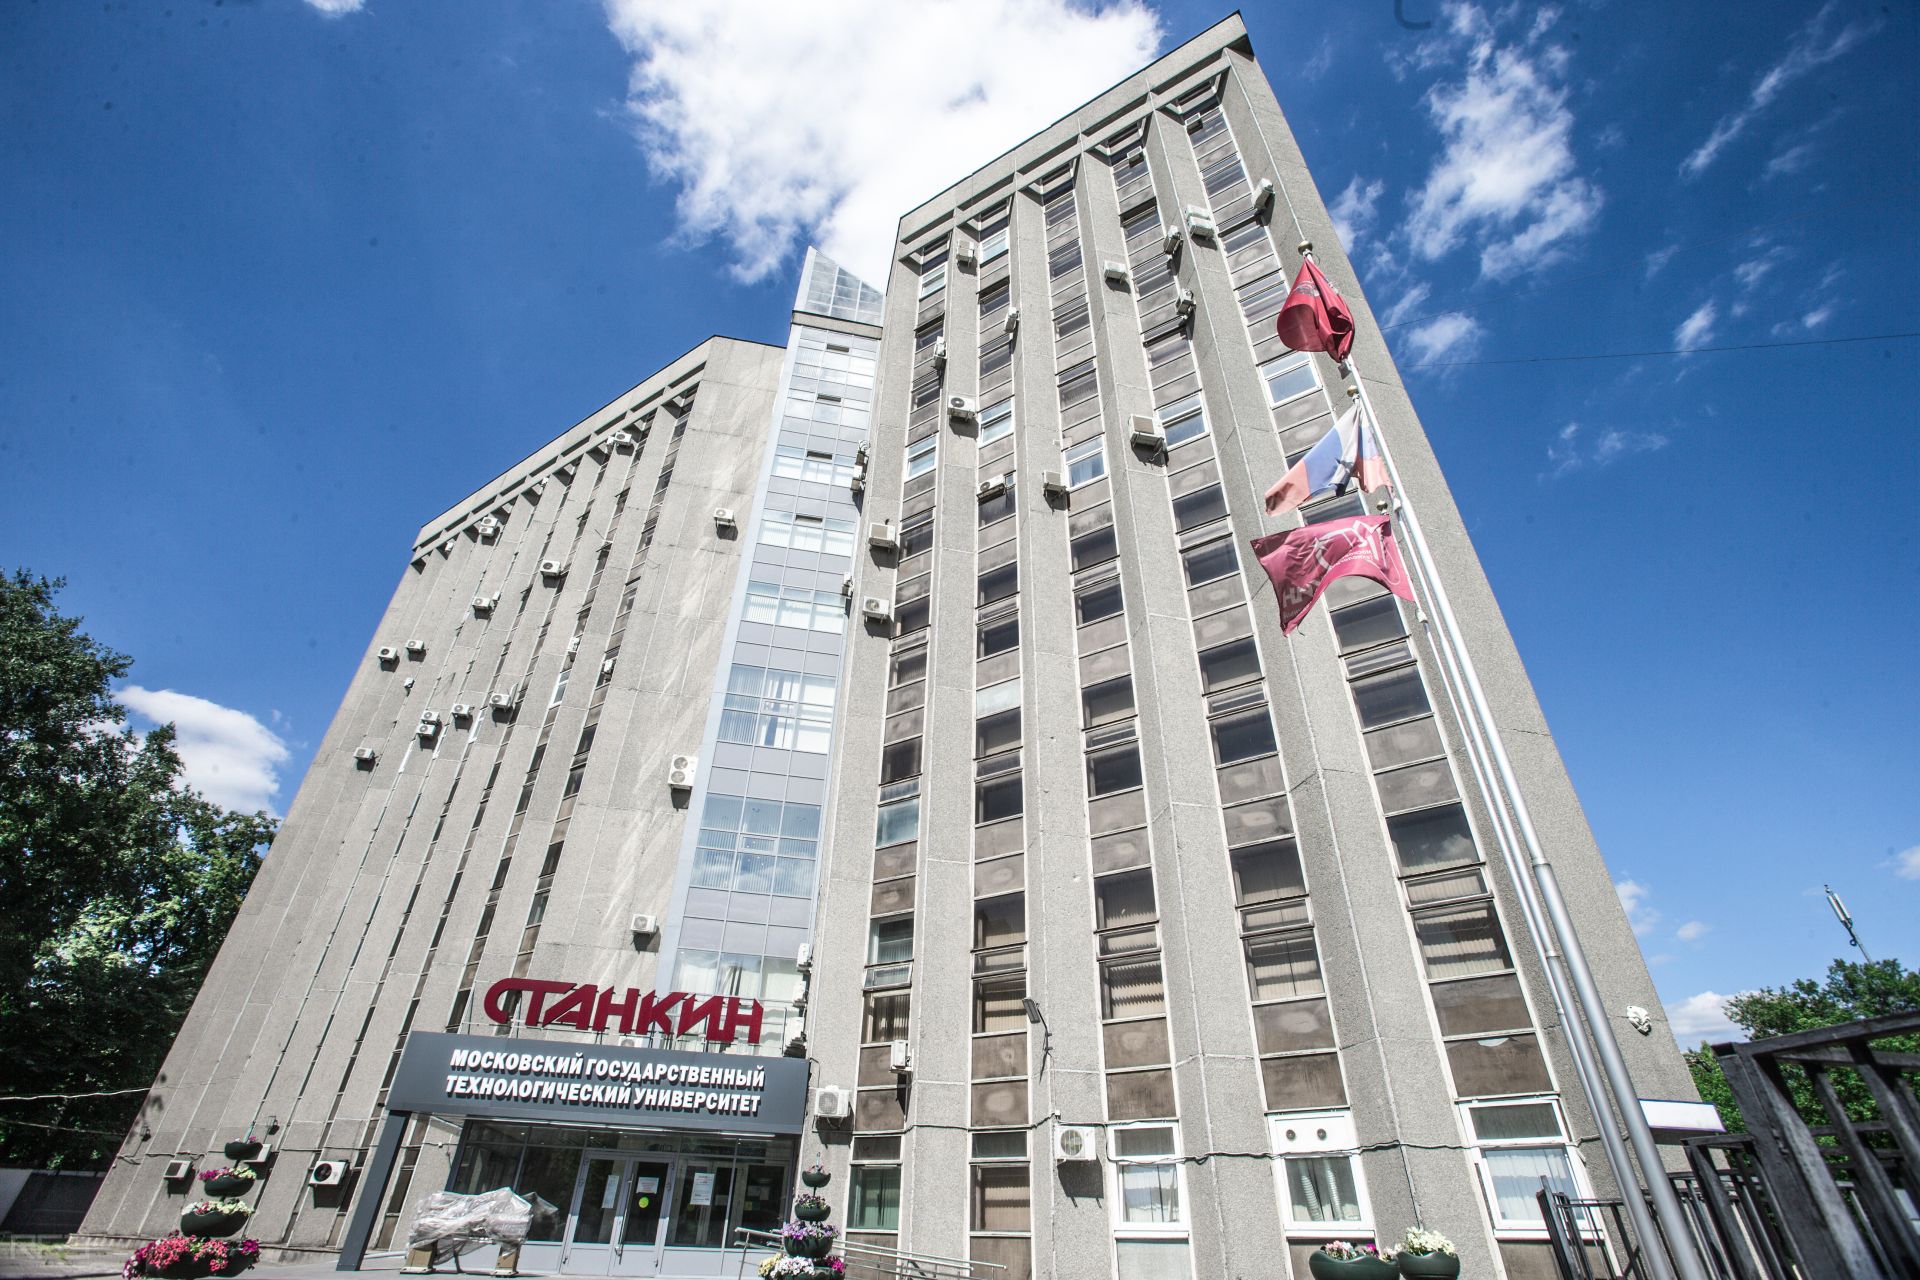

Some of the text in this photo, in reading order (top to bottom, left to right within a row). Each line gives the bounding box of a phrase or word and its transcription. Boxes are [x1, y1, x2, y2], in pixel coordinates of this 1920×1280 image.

[484, 978, 764, 1044] СТАНКИН
[450, 1049, 765, 1088] МОСКОВСКИЙ ГОСУДАРСТВЕННЫЙ
[445, 1075, 761, 1113] ТЕХНОЛОГИЧЕСКИЙ УНИВЕРСИТЕТ
